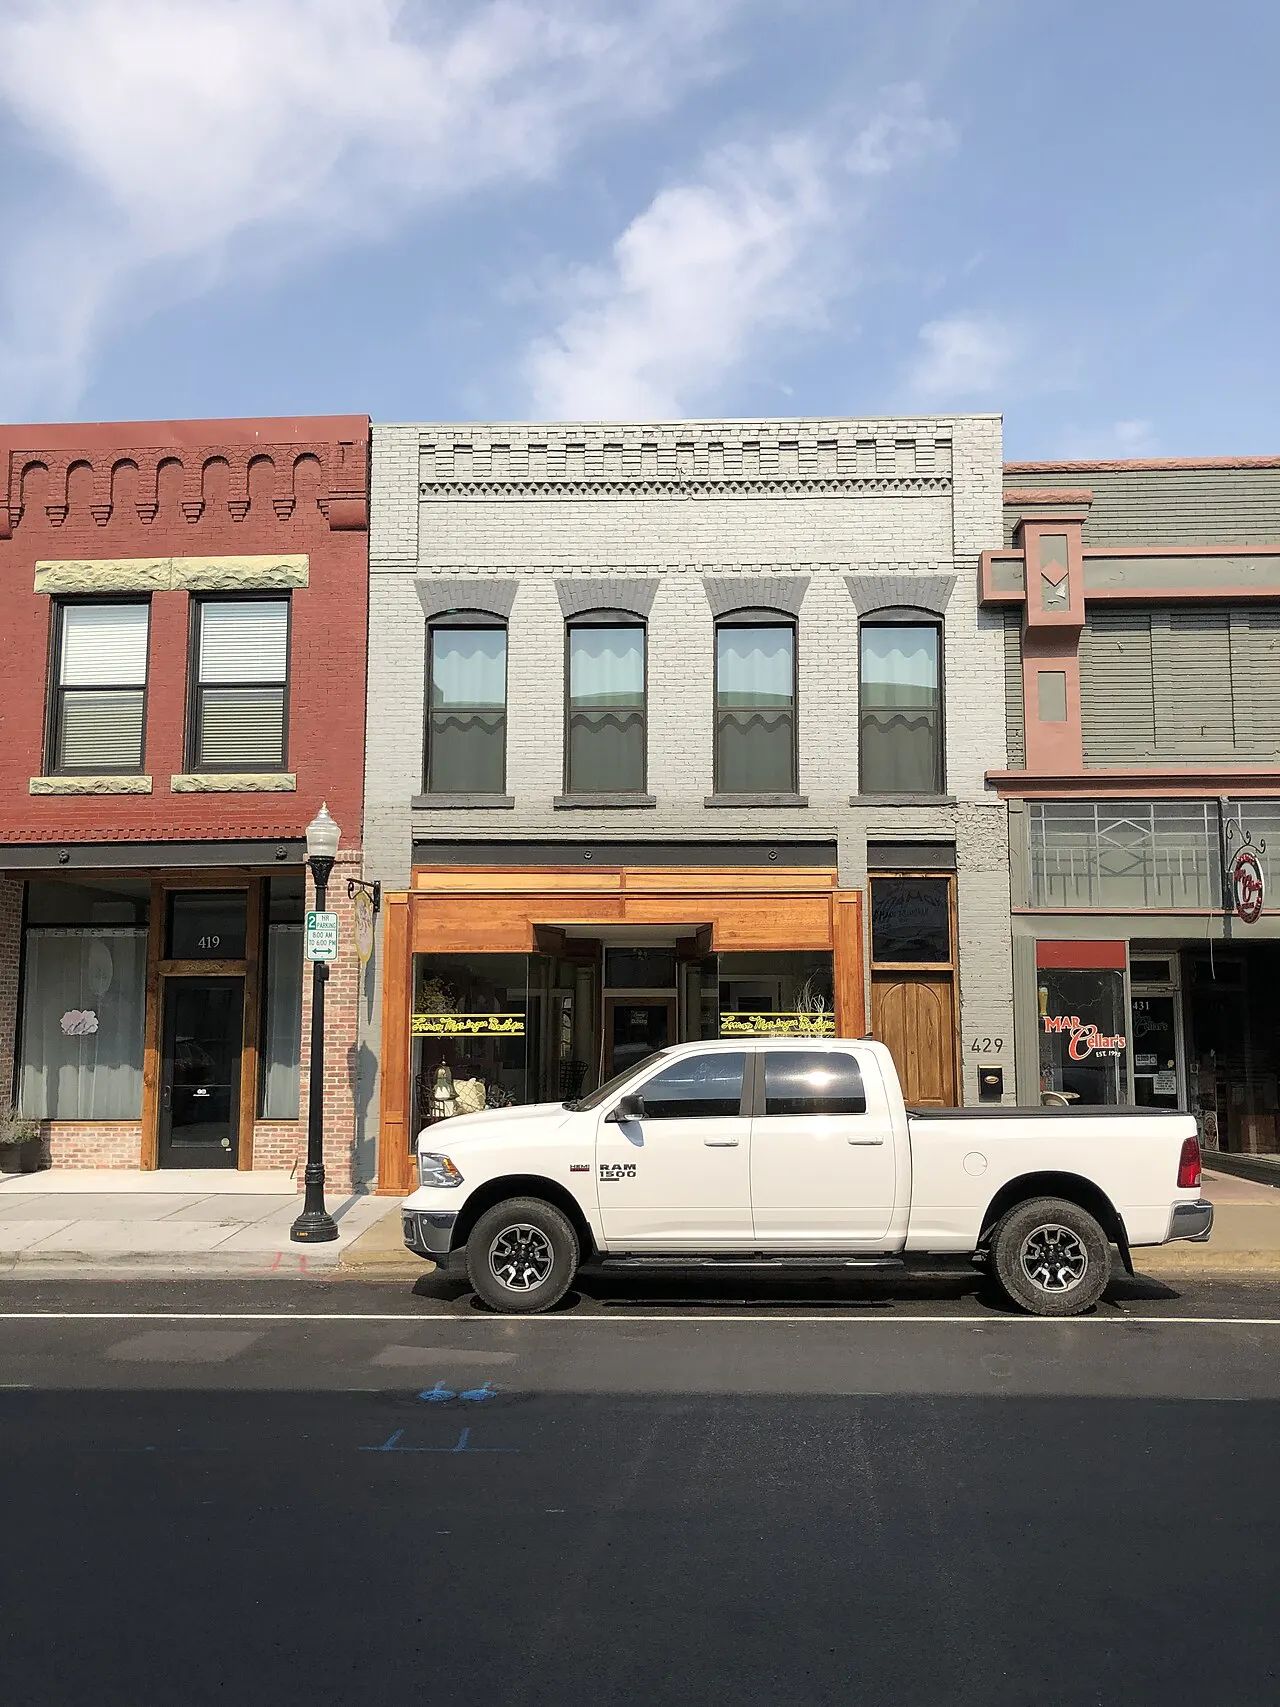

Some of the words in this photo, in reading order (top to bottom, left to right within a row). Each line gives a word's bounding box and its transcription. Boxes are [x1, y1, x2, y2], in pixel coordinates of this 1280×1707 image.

[308, 915, 316, 929] 2
[198, 935, 220, 949] 419
[1132, 1001, 1149, 1011] 431
[1042, 1016, 1081, 1033] MAR
[971, 1037, 1004, 1053] 429
